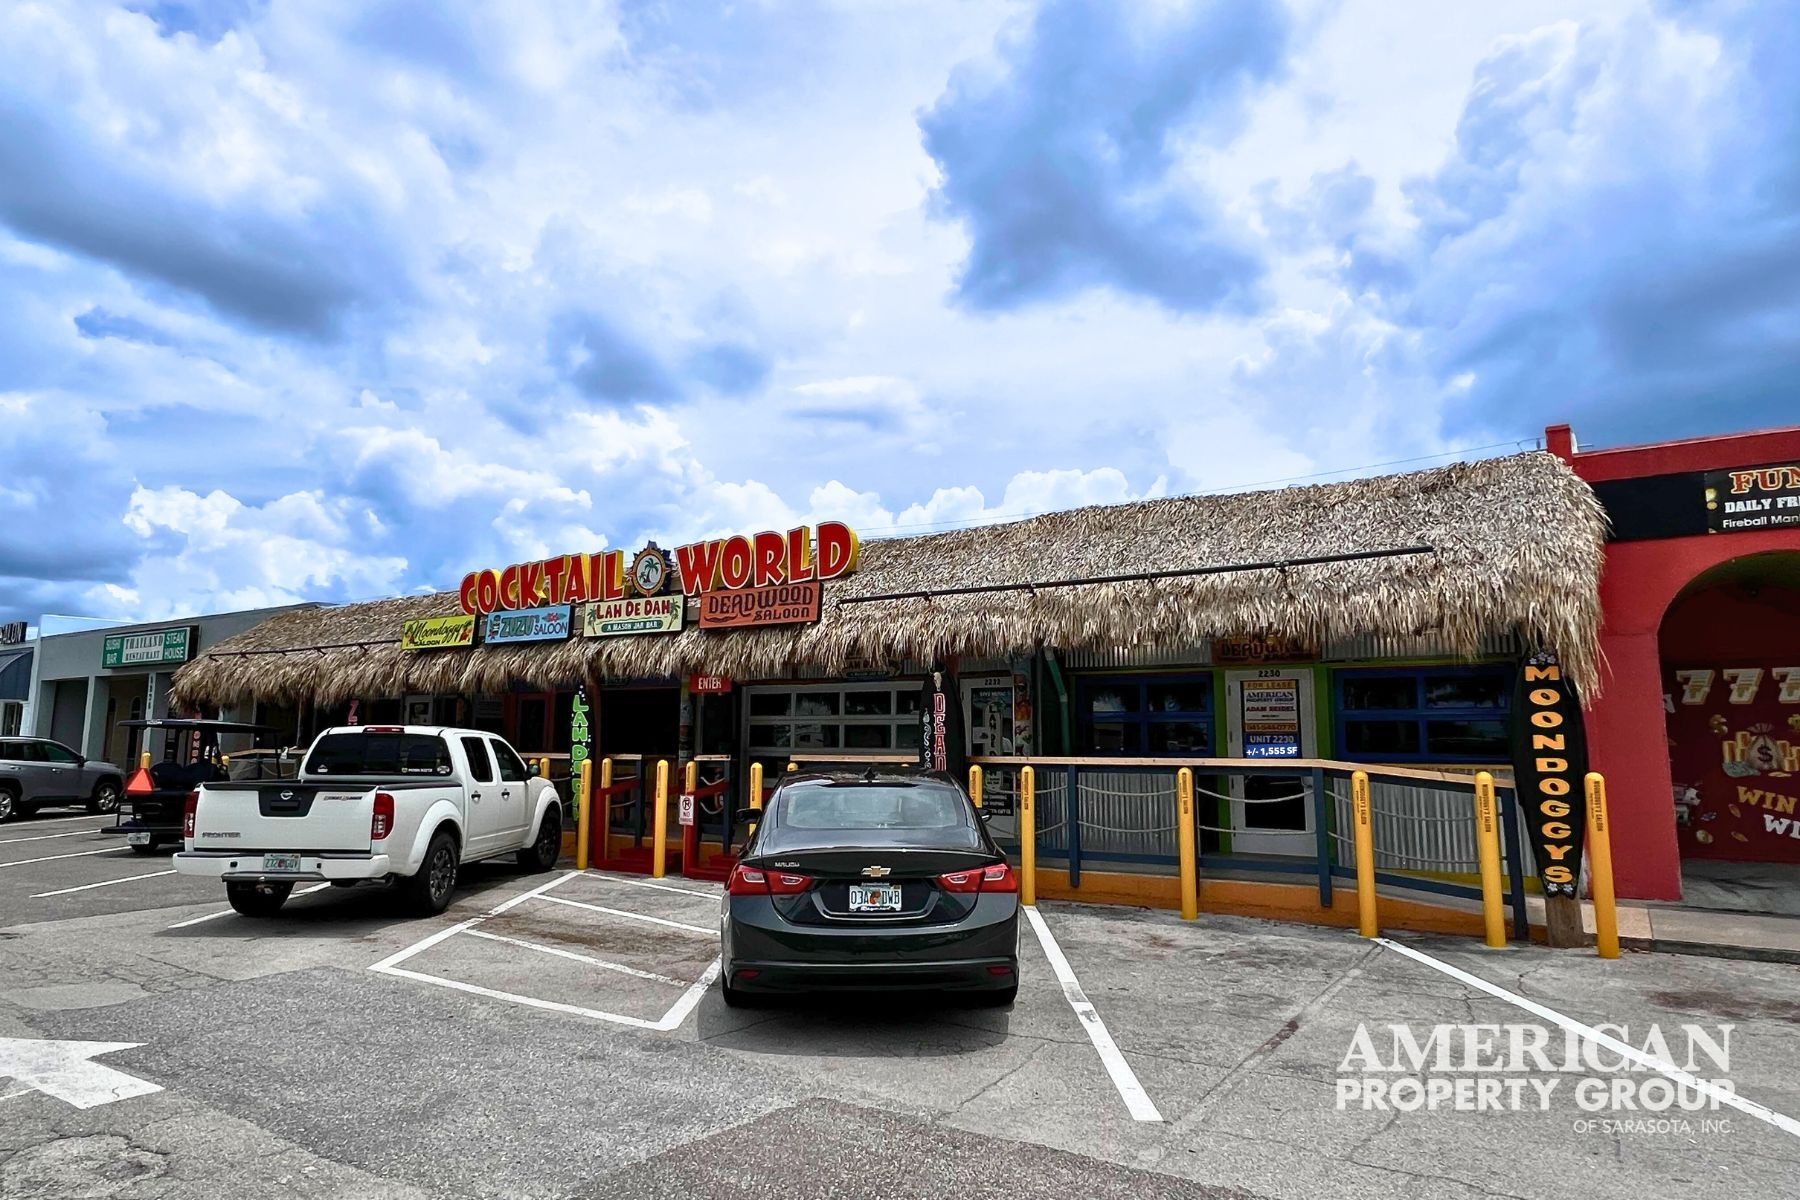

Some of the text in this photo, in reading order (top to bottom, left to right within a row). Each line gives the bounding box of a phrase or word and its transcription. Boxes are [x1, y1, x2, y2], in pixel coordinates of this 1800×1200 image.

[1725, 496, 1800, 513] DAILY FR
[1723, 516, 1767, 528] Fireball
[460, 521, 857, 614] COCKTAIL WORLD
[708, 585, 813, 618] DEADWOOD
[596, 599, 671, 619] LAH DE DAH
[752, 607, 810, 622] SALOON
[534, 621, 567, 635] SALOON
[613, 623, 631, 631] MASON
[633, 622, 645, 630] JAR
[646, 621, 658, 629] BAR
[125, 635, 163, 649] THAILAND
[166, 632, 185, 645] STEAK
[164, 647, 184, 659] HOUSE
[1258, 670, 1281, 678] 2230
[698, 677, 722, 690] ENTER
[572, 694, 589, 741] LAH
[1250, 735, 1294, 743] UNIT 2230
[1246, 746, 1297, 756] +/- 1,555 SF
[1525, 665, 1573, 883] MOONDOGGYS
[1736, 786, 1798, 815] WIN
[882, 890, 900, 904] DWB
